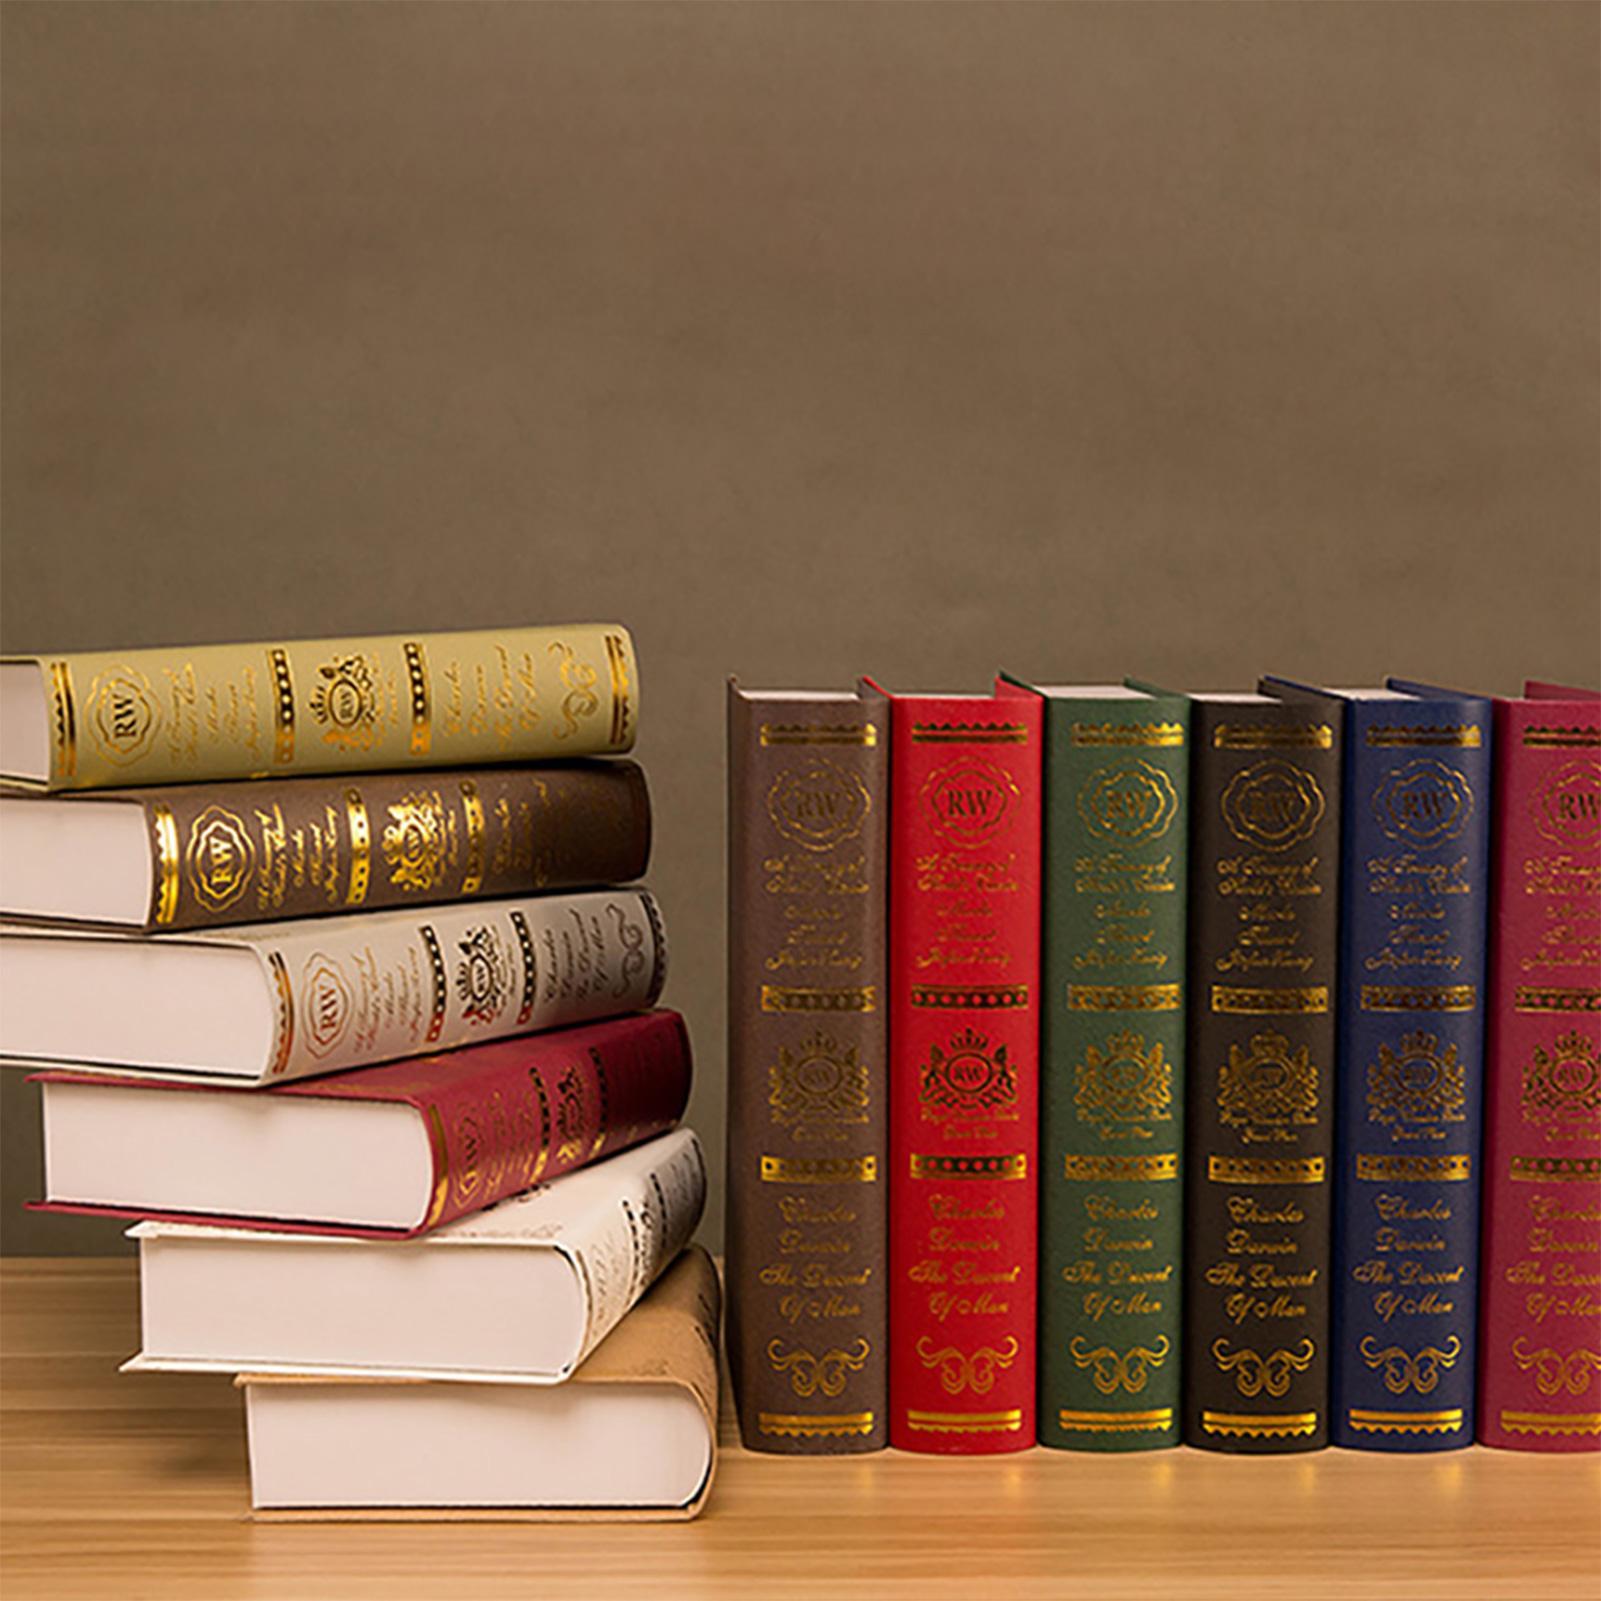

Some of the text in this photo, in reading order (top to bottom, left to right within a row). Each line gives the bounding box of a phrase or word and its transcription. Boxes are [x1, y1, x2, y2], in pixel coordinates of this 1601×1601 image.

[112, 693, 137, 738] RW
[796, 790, 838, 818] RW
[948, 789, 993, 817] RW
[1106, 791, 1152, 818] RW
[1401, 791, 1448, 819] RW
[209, 836, 233, 885] RW
[319, 985, 338, 1031] RW
